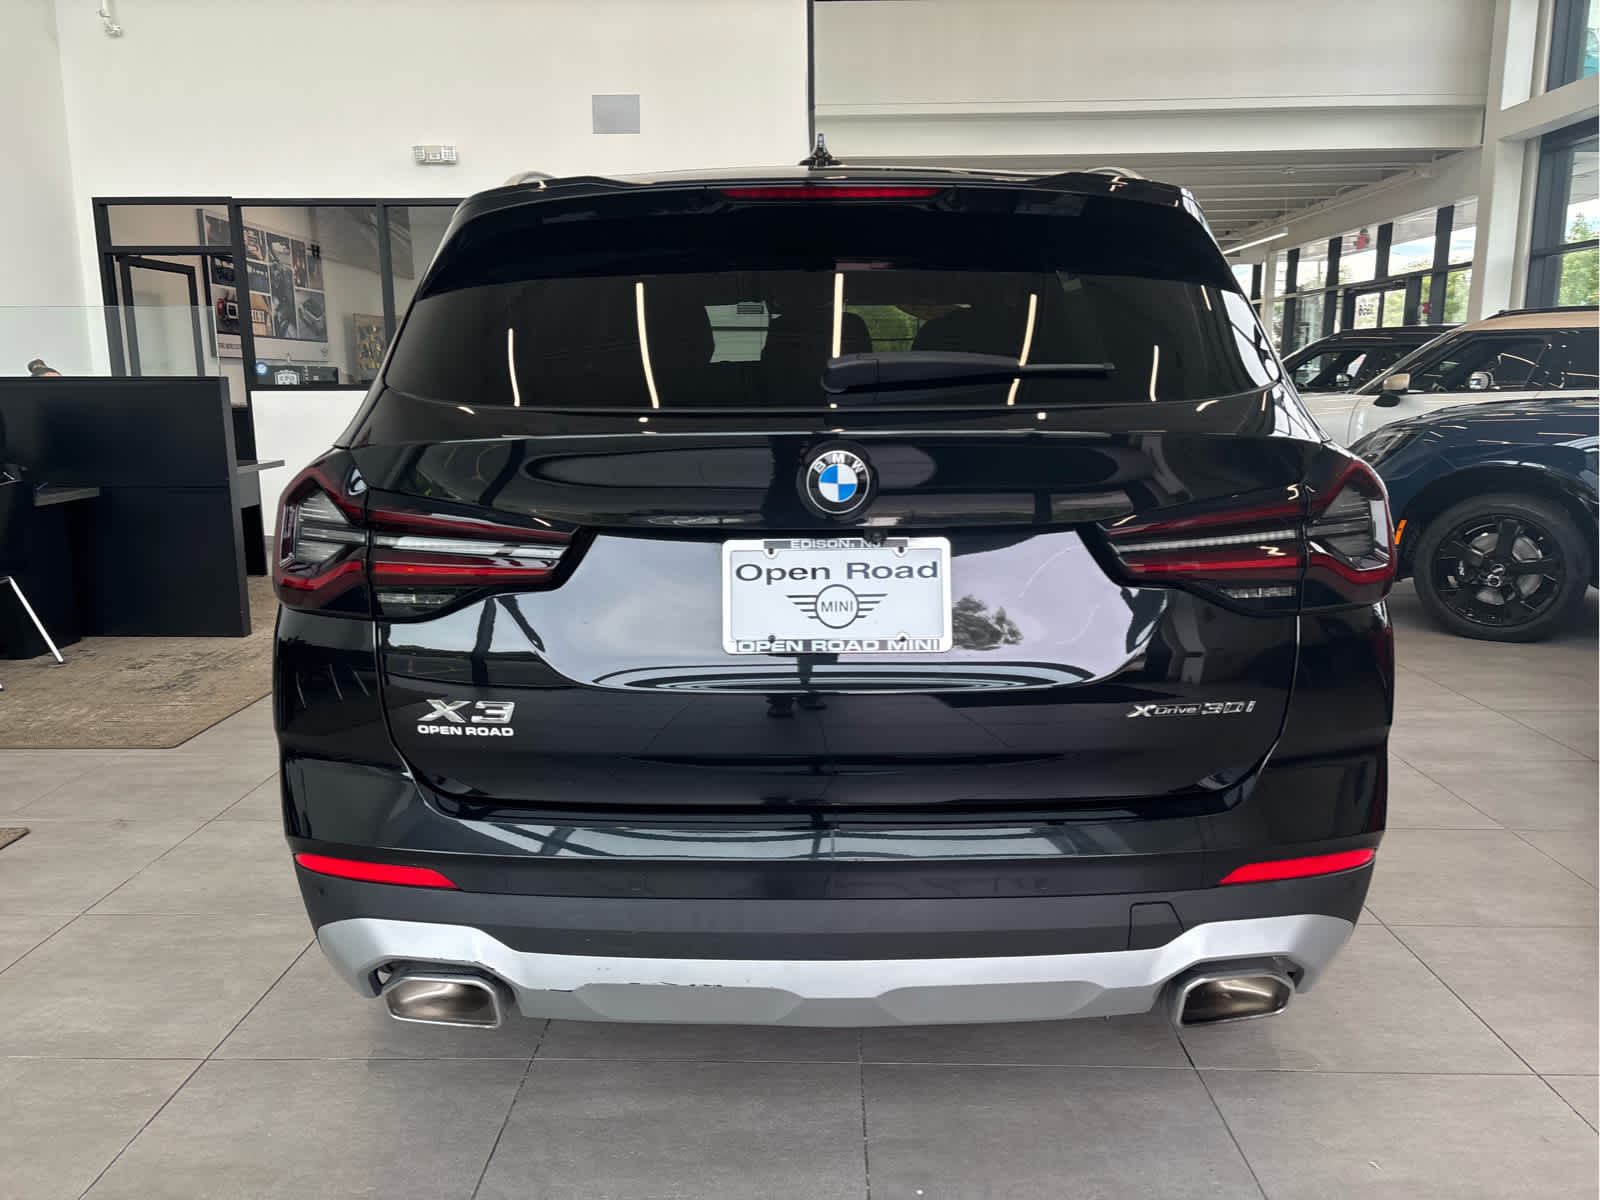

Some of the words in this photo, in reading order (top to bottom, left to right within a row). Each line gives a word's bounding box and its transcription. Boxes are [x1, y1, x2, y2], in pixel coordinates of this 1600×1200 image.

[813, 453, 864, 474] BMW
[735, 563, 831, 585] Open
[846, 561, 939, 580] Road
[820, 600, 854, 613] MINI
[737, 639, 804, 652] OPEN
[811, 639, 880, 652] ROAD
[887, 638, 939, 651] MINI
[417, 699, 516, 724] X3
[417, 724, 463, 736] OPEN
[465, 726, 515, 737] ROAD
